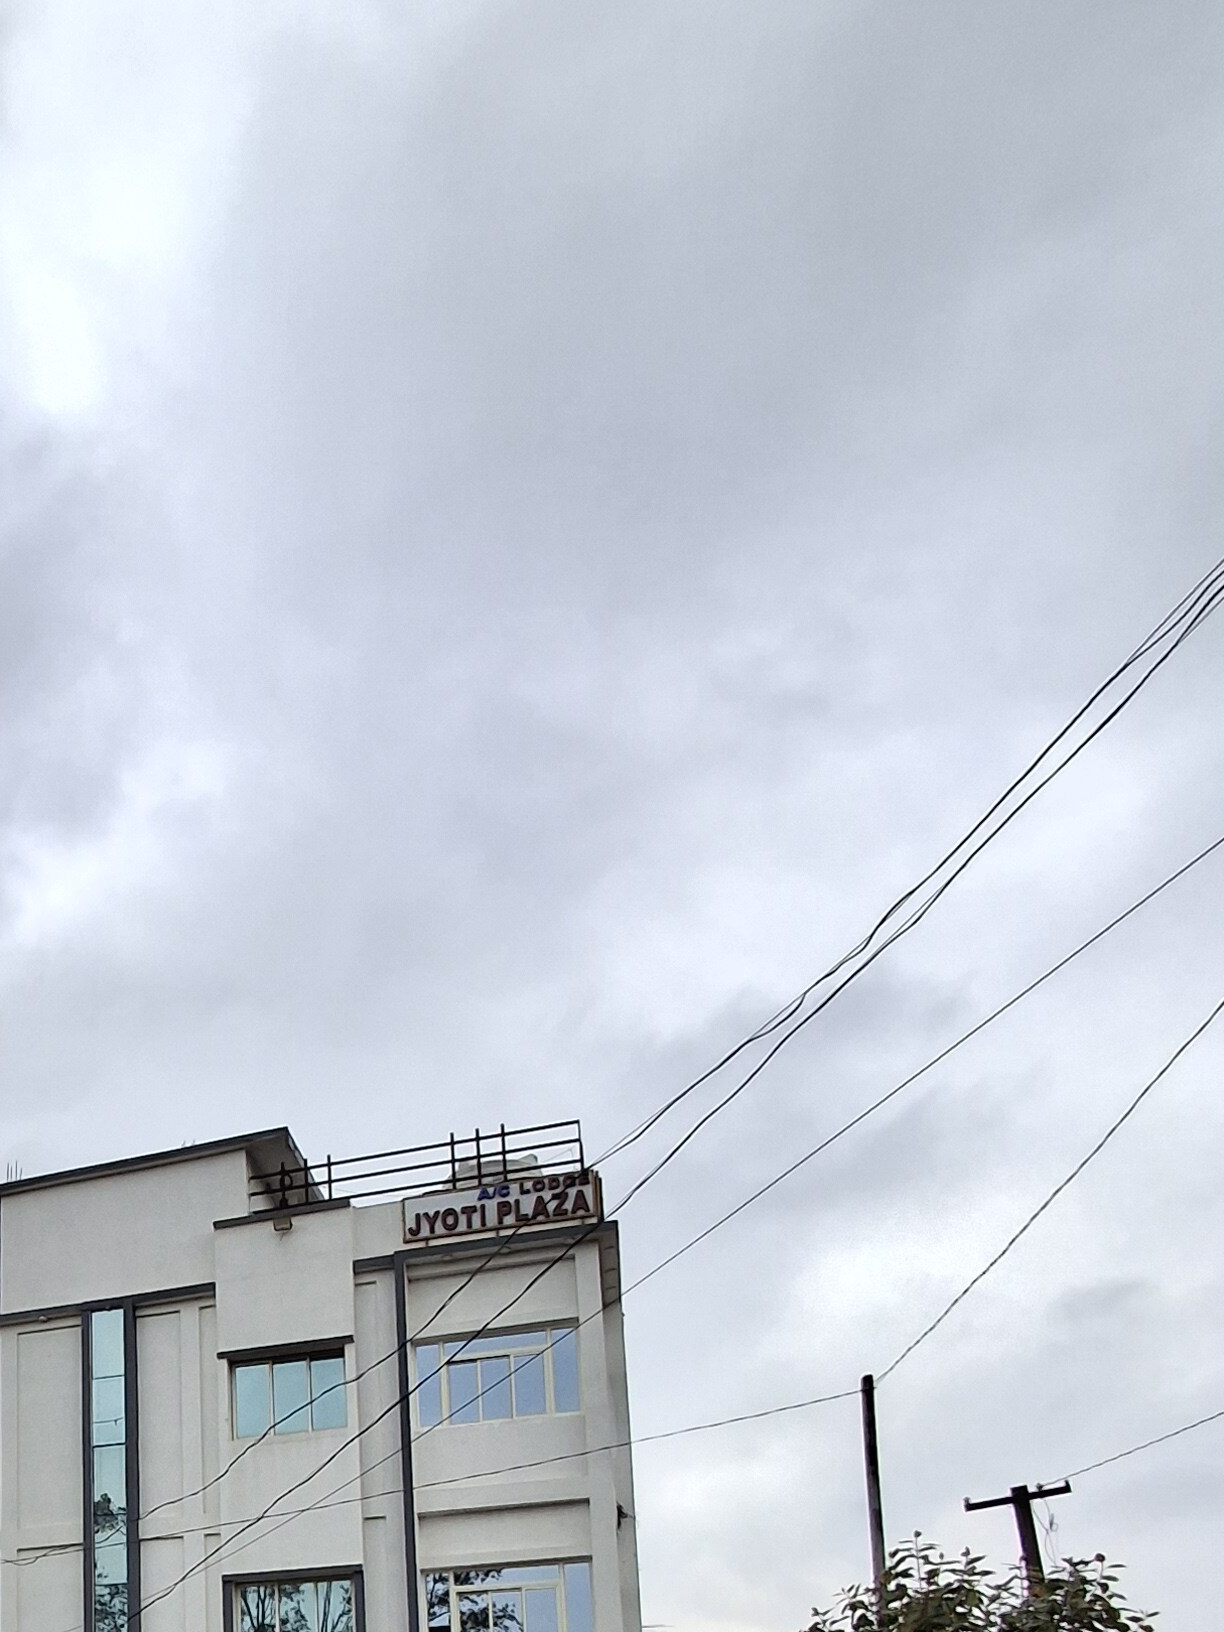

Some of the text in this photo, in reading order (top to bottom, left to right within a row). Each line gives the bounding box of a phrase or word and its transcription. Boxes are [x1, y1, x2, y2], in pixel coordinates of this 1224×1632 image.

[477, 1173, 591, 1201] A/C LODGE
[408, 1189, 591, 1237] JYOTI PLAZA
